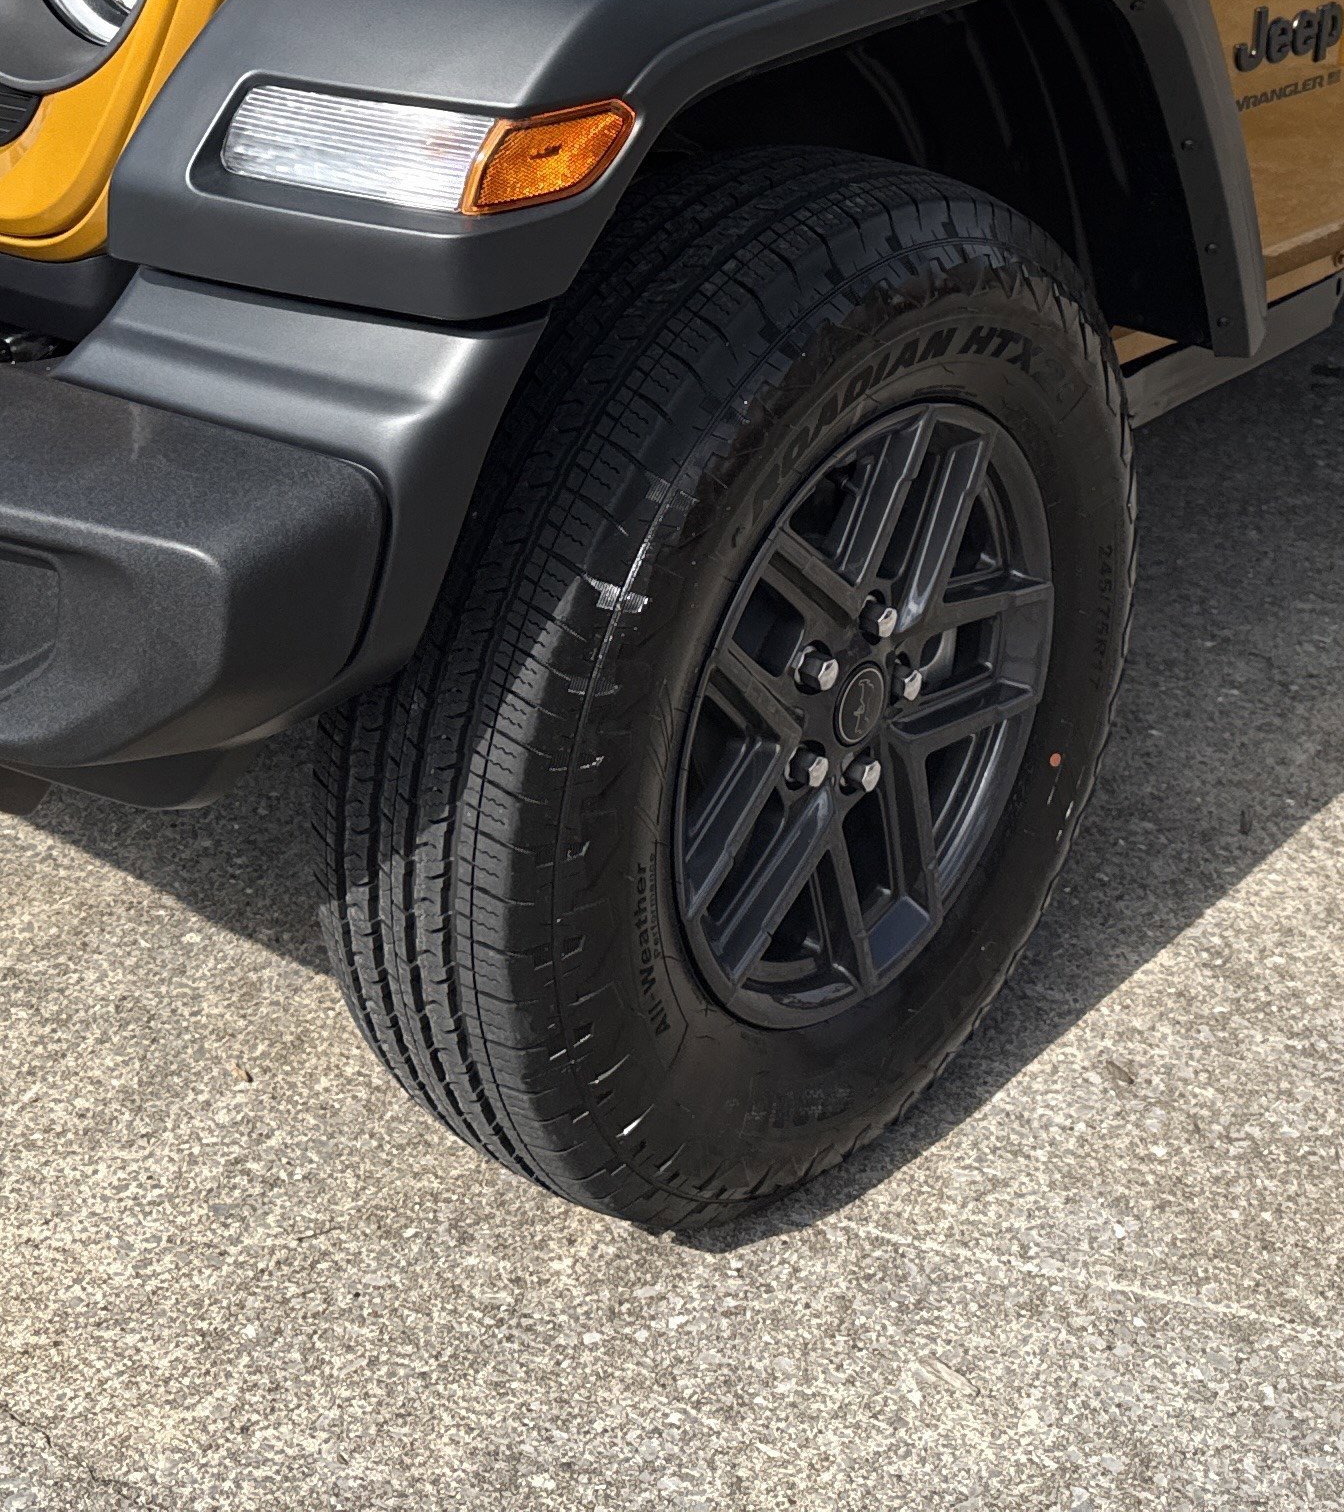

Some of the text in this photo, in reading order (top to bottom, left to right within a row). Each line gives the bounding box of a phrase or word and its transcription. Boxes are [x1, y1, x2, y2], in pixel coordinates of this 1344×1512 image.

[1234, 1, 1344, 72] Jeep
[1236, 75, 1325, 112] WRANGLER
[634, 864, 671, 1036] All-Weather
